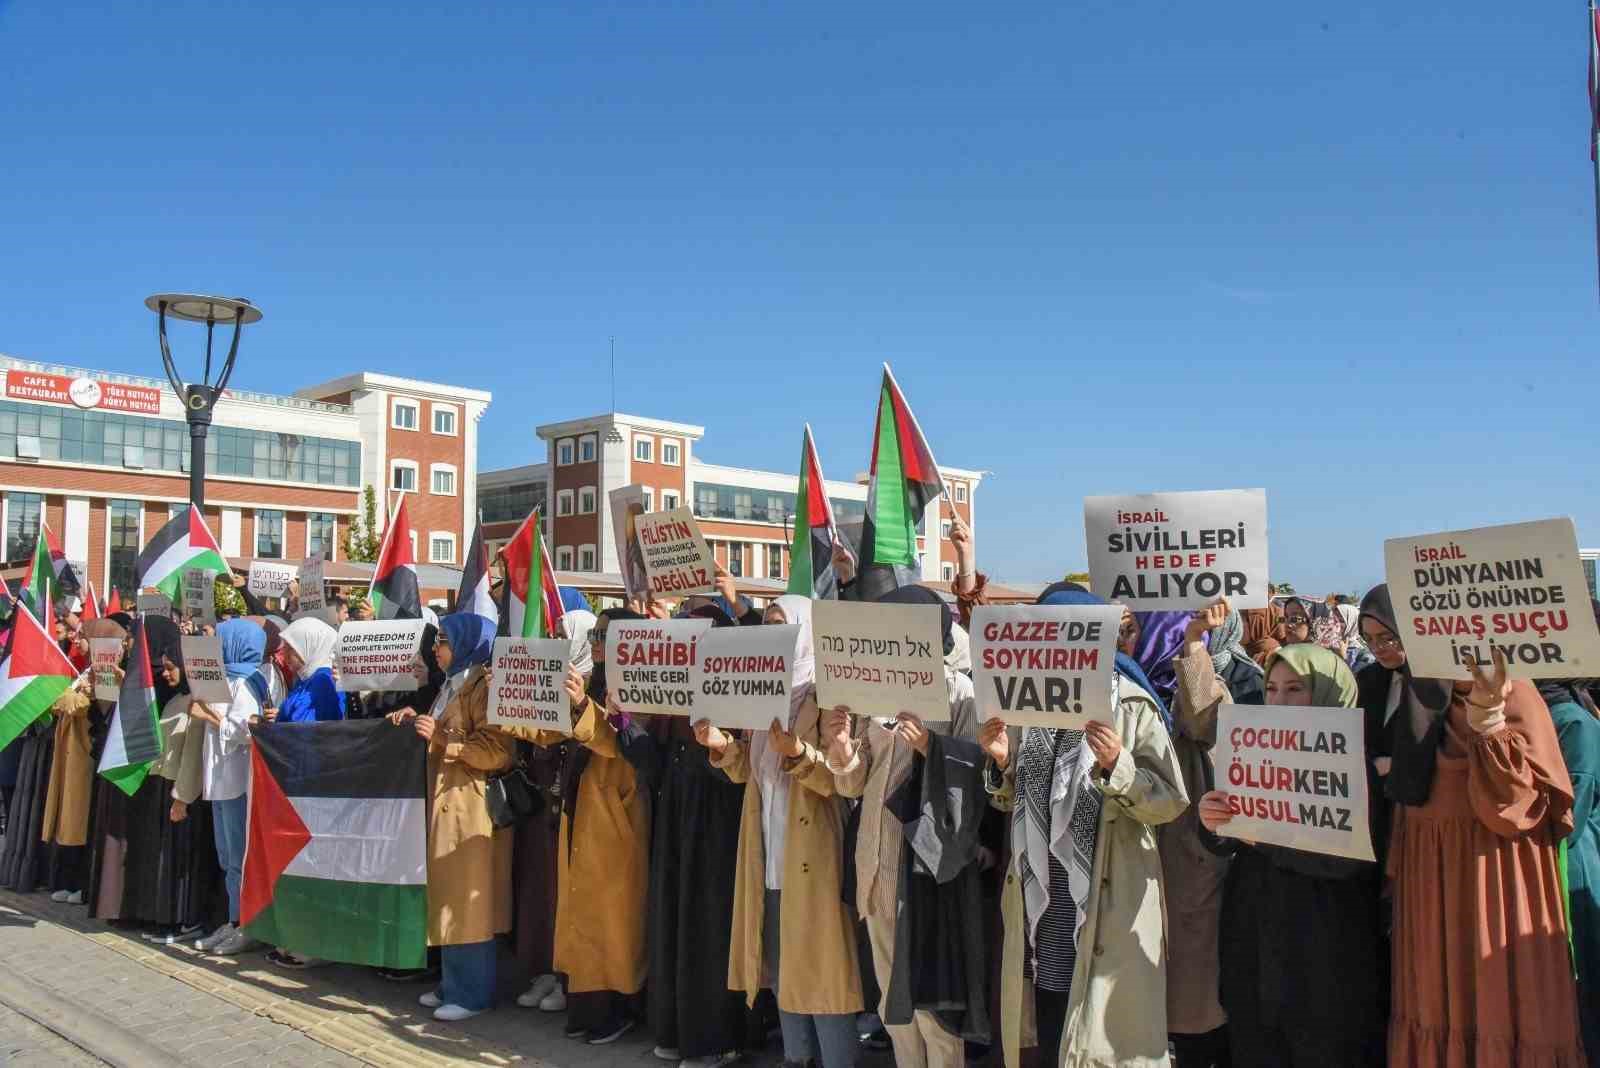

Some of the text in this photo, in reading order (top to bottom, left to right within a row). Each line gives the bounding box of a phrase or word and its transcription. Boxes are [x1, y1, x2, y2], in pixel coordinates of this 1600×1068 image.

[23, 376, 47, 388] CAFE
[1117, 508, 1169, 525] İSRAİL
[641, 517, 693, 545] FİLİSTİN
[1108, 521, 1246, 552] SİVİLLERİ
[1135, 553, 1217, 569] HEDEF
[1414, 542, 1467, 563] İSRAİL
[652, 565, 712, 593] DEĞİLİZ
[1414, 557, 1544, 588] DÜNYANIN
[1110, 571, 1248, 600] ALIYOR
[1409, 585, 1566, 612] GÖZÜ ÖNÜNDE
[618, 629, 664, 641] TOPRAK
[1413, 609, 1569, 640] SAVAŞ SUÇU
[341, 643, 413, 653] INCOMPLETE WITHOUT
[342, 632, 416, 643] OUR FREEDOM IS
[821, 633, 932, 658] אל תשתק מה
[342, 653, 413, 664] THE FREEDOM OF
[508, 642, 529, 655] KATİL
[616, 635, 697, 666] SAHİBİ
[497, 653, 563, 673] SİYONİSTLER
[703, 655, 786, 674] SOYKIRIMA
[982, 648, 1099, 671] SOYKIRIM
[504, 672, 553, 688] KADIN VE
[623, 668, 689, 684] EVİNE GERİ
[824, 661, 933, 689] שקרה בפלסטין
[498, 686, 560, 704] ÇOCUKLARI
[702, 676, 786, 696] GÖZ YUMMA
[993, 676, 1083, 714] VAR!
[497, 703, 559, 722] ÖLDÜRÜYOR
[1230, 727, 1348, 755] ÇOCUKLAR
[1228, 757, 1350, 798] ÖLÜRKEN
[1227, 795, 1353, 832] SUSULMAZ
